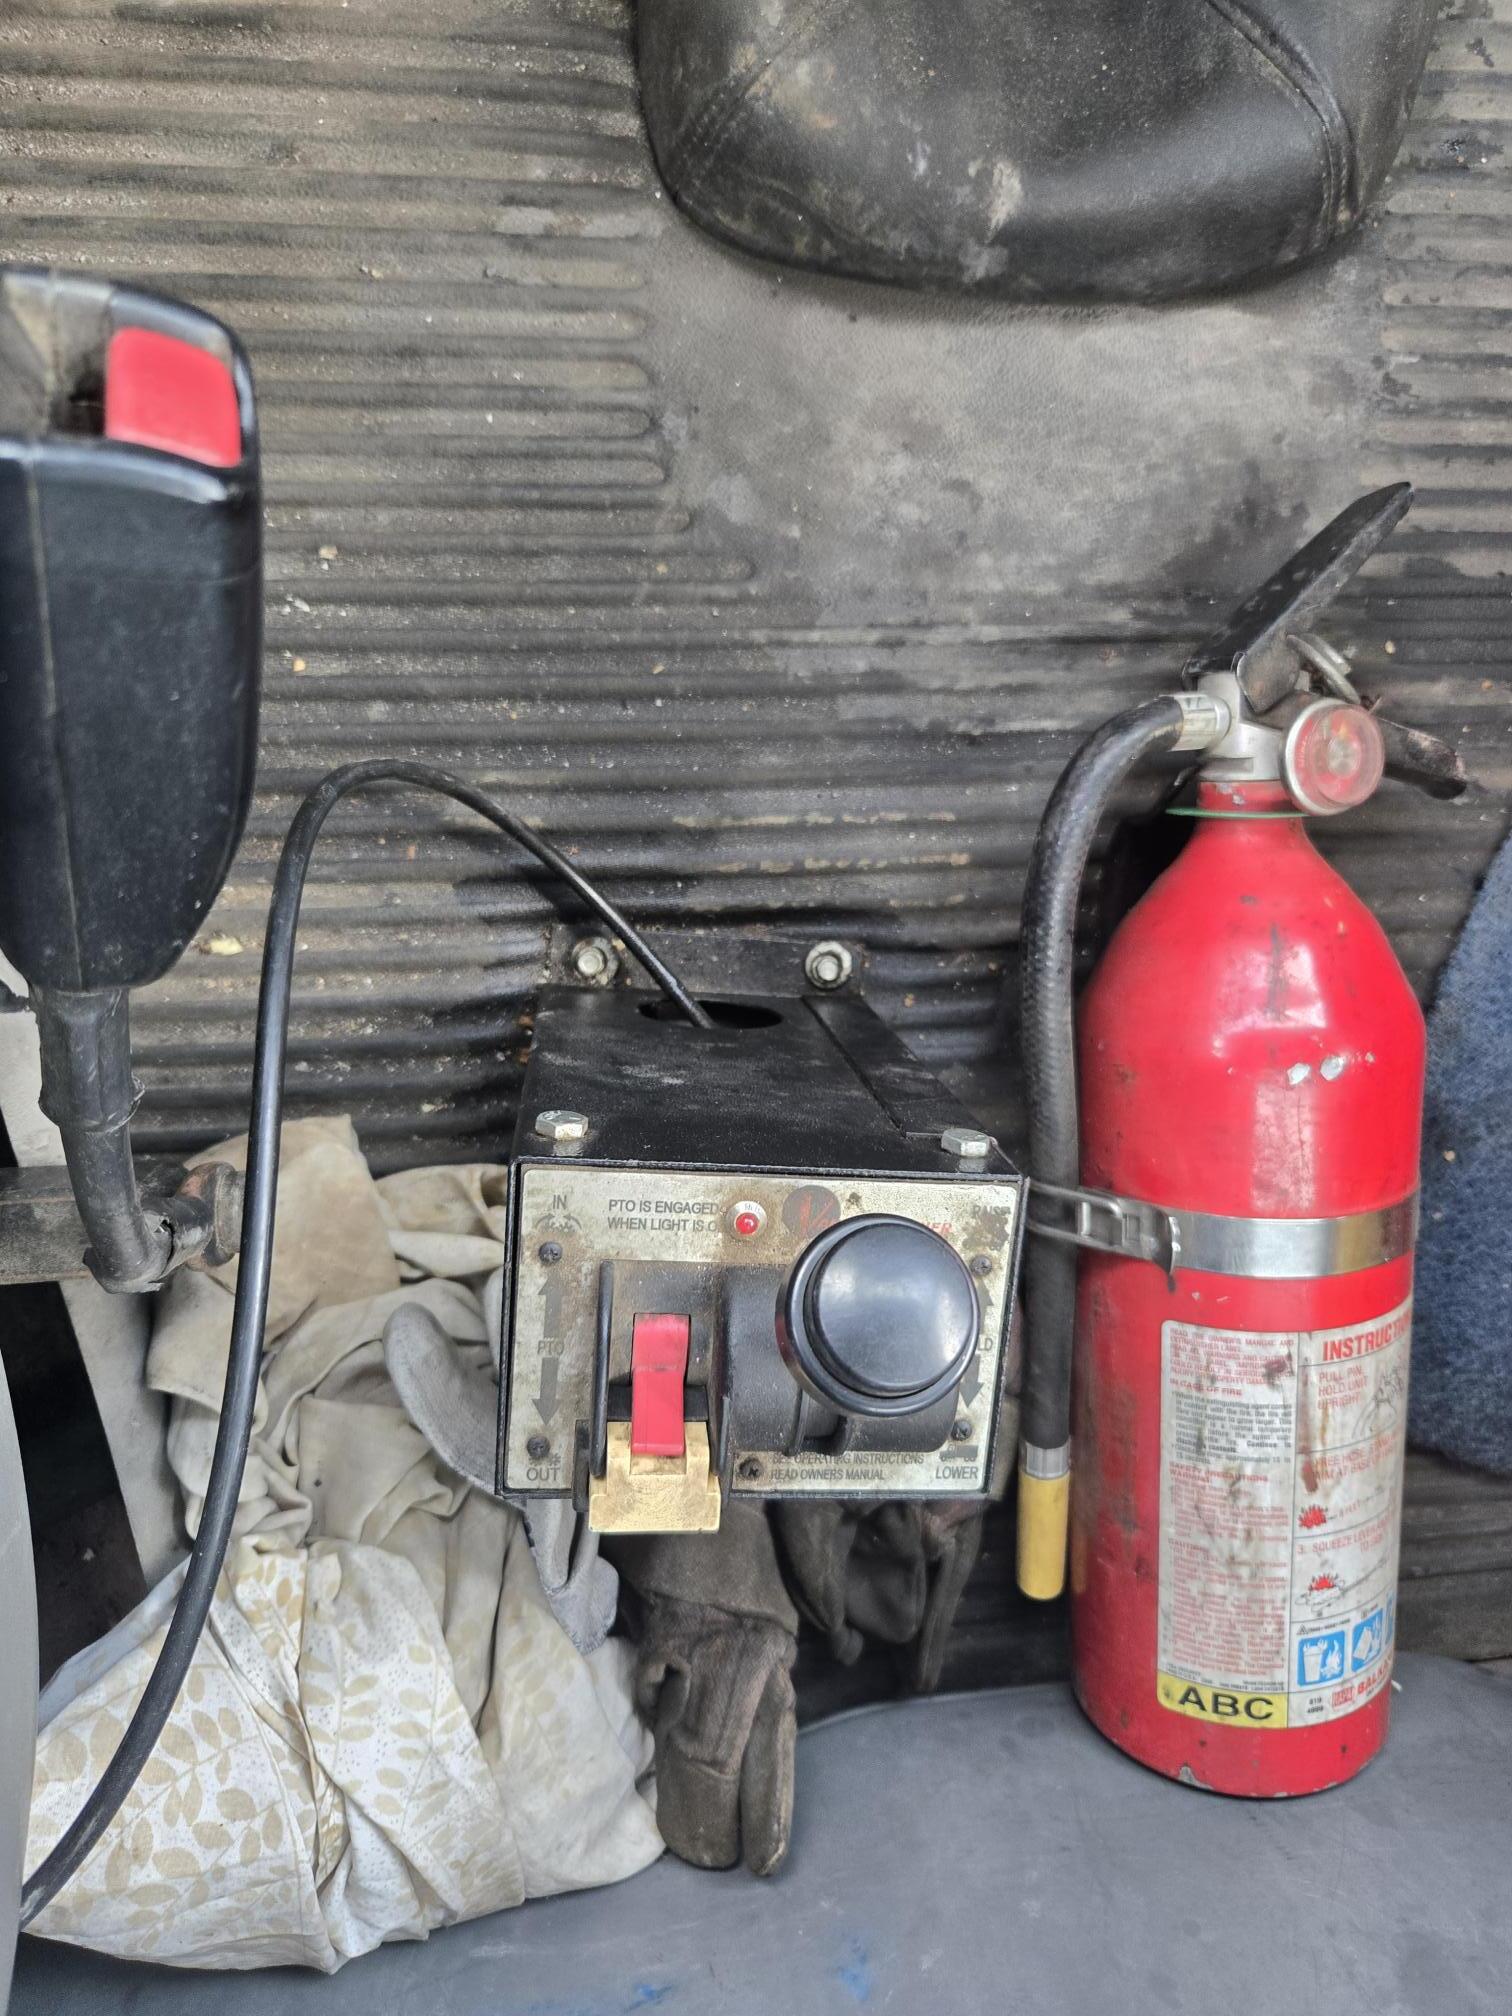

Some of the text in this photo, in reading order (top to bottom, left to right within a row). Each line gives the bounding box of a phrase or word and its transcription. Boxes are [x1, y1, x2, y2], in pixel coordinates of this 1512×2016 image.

[552, 1194, 567, 1210] IN
[608, 1200, 719, 1214] PTO IS ENGAGED
[607, 1217, 646, 1230] WHEN
[650, 1218, 688, 1231] LIGHT
[692, 1220, 704, 1232] IS
[537, 1340, 564, 1355] PTO
[1318, 1382, 1345, 1397] HOLD
[854, 1452, 925, 1465] INSTRUCTIONS
[526, 1467, 560, 1481] OUT
[771, 1467, 886, 1481] READ OWNERS MANUAL
[935, 1466, 978, 1480] LOWER
[1312, 1535, 1352, 1553] SQUEEZE
[1178, 1685, 1273, 1720] ABC
